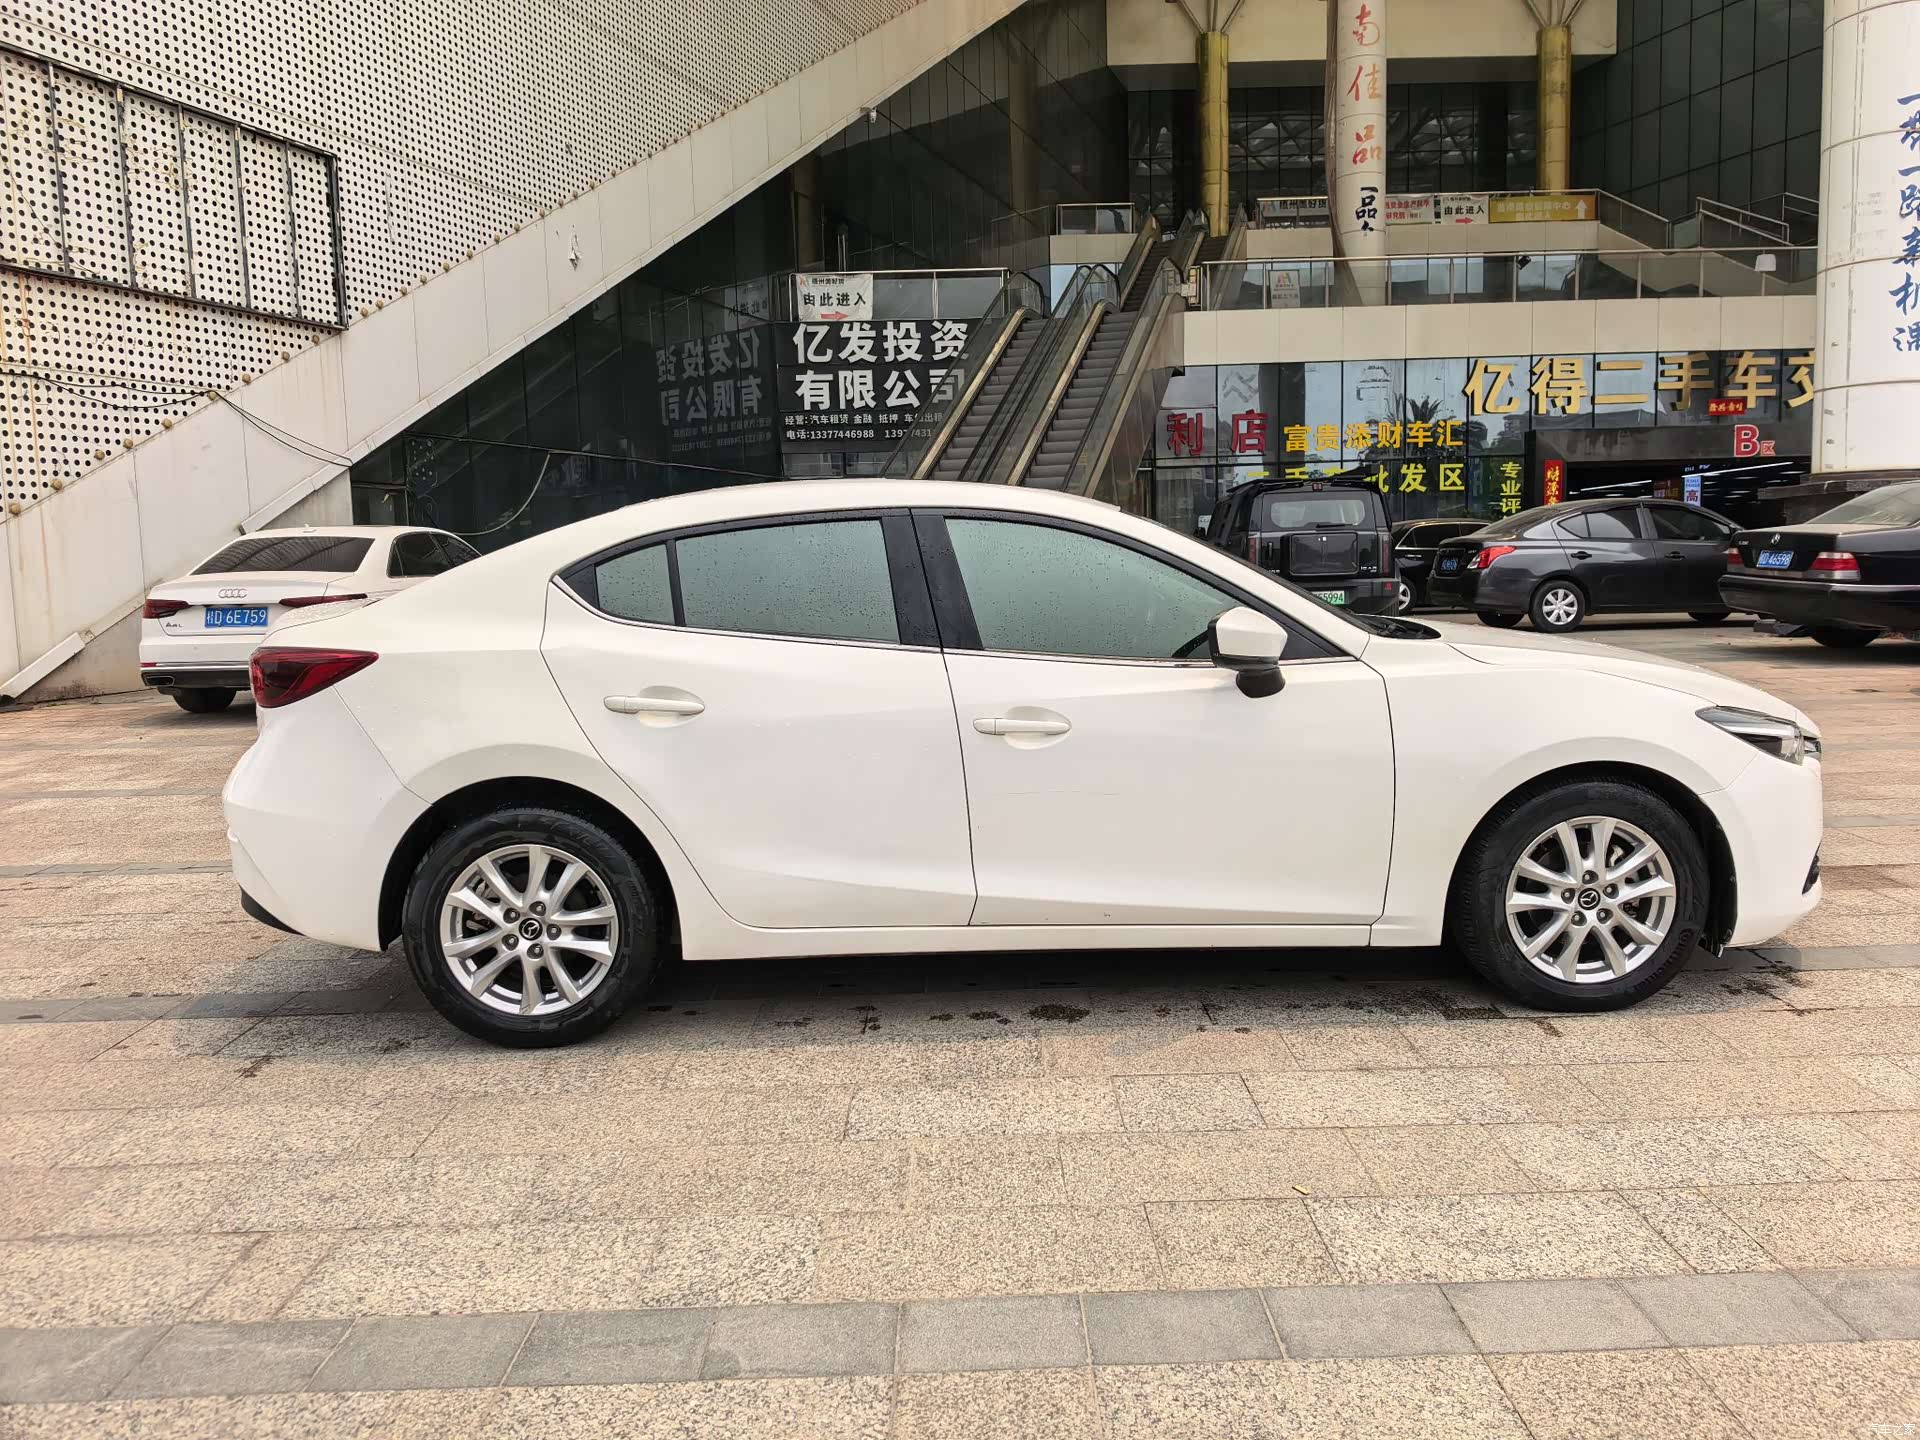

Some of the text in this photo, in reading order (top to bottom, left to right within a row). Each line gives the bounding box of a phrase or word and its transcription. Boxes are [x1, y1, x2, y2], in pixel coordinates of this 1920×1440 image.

[1444, 205, 1485, 215] 由此进入
[803, 292, 866, 307] 由此进入
[792, 321, 969, 364] 亿发投资
[795, 369, 966, 411] 有限公司
[853, 413, 873, 424] 金融
[878, 413, 899, 424] 抵押
[1167, 410, 1268, 456] 利店
[1284, 420, 1465, 452] 富贵添财车汇
[1500, 462, 1522, 516] 专业评
